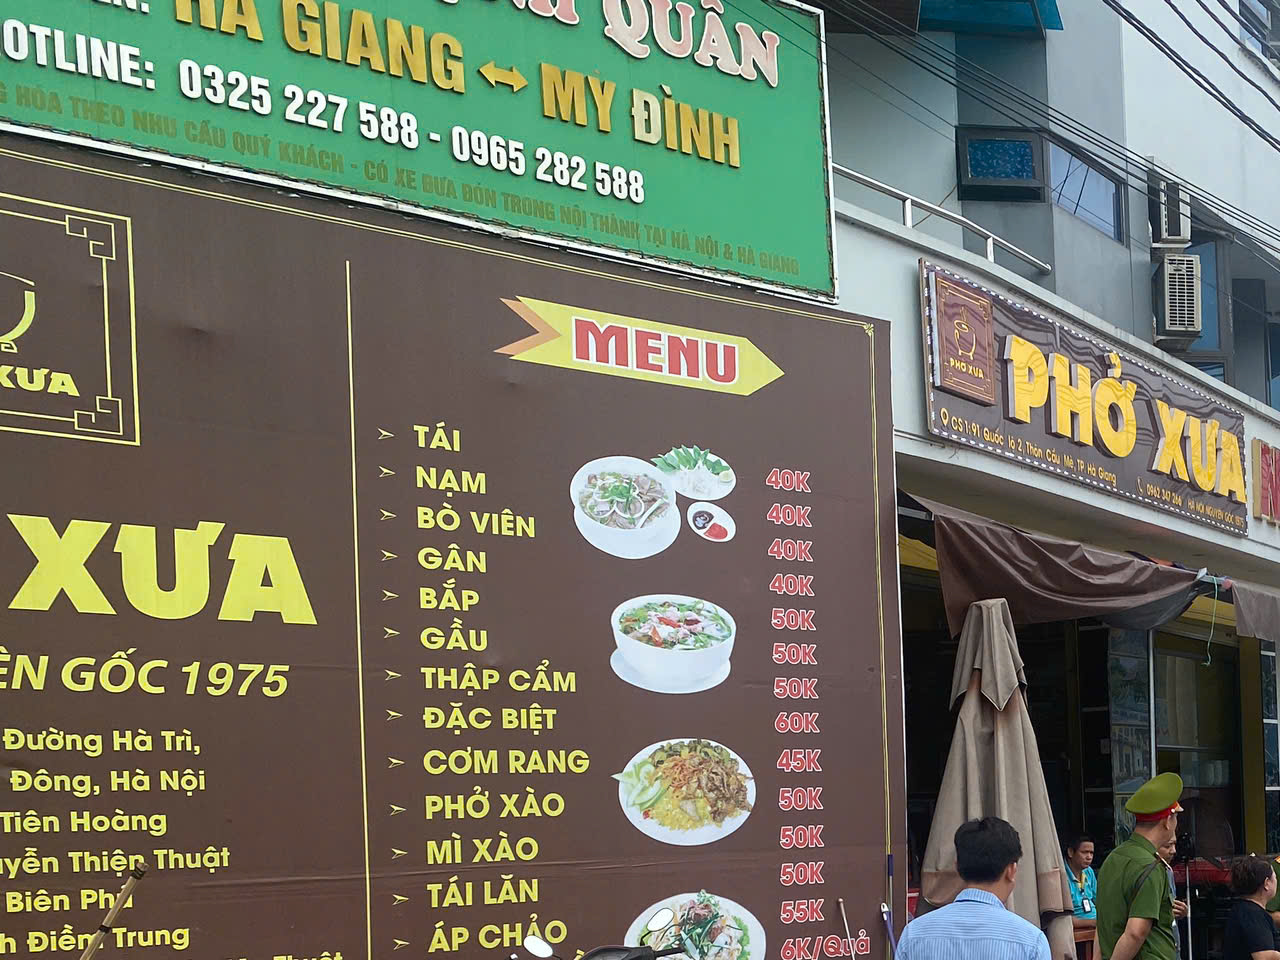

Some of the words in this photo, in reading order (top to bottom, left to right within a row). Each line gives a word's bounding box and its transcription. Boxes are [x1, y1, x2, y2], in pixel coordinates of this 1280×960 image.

[283, 0, 466, 93] GIANG
[631, 84, 741, 168] ĐÌNH
[0, 18, 156, 90] OTLINE:
[179, 58, 272, 115] 0325
[284, 83, 349, 133] 227
[359, 100, 419, 149] 588
[452, 125, 526, 177] 0965
[535, 147, 587, 191] 282
[595, 161, 645, 203] 588
[69, 95, 125, 127] THEO
[132, 109, 177, 137] NHU
[394, 167, 417, 190] XE
[571, 315, 739, 386] MENU
[1003, 335, 1138, 459] PHỞ
[1149, 398, 1247, 504] XƯA
[413, 420, 461, 452] TÁI
[984, 426, 1004, 446] Quốc
[1098, 467, 1117, 486] Giang
[415, 465, 487, 498] NẠM
[765, 469, 811, 494] 40K
[417, 501, 460, 531] BÒ
[470, 508, 536, 538] VIÊN
[767, 503, 812, 528] 40K
[417, 542, 487, 573] GÂN
[768, 538, 814, 563] 40K
[7, 514, 318, 625] XƯA
[419, 578, 480, 612] BẮP
[769, 573, 815, 598] 40K
[420, 617, 488, 652] GẦU
[771, 608, 816, 632] 50K
[772, 642, 817, 666] 50K
[61, 647, 169, 695] GỐC
[181, 661, 290, 698] 1975
[420, 662, 500, 696] THẬP
[508, 659, 577, 693] CẨM
[773, 677, 819, 700] 50K
[422, 702, 492, 735] ĐẶC
[501, 702, 557, 735] BIỆT
[775, 711, 820, 734] 60K
[3, 727, 103, 757] Đường
[112, 729, 153, 752] Hà
[161, 728, 201, 756] Trì,
[423, 746, 498, 776] CƠM
[509, 749, 590, 774] RANG
[777, 749, 822, 773] 45K
[10, 768, 101, 798] Đông,
[110, 768, 150, 792] Hà
[160, 768, 206, 797] Nội
[425, 785, 490, 820] PHỞ
[500, 786, 565, 818] XÀO
[779, 787, 824, 811] 50K
[0, 809, 60, 834] Tiên
[70, 808, 168, 836] Hoàng
[780, 825, 824, 849] 50K
[153, 846, 231, 874] Thuật
[426, 832, 462, 866] MÌ
[472, 831, 539, 864] XÀO
[780, 862, 824, 886] 50K
[6, 888, 70, 913] Biên
[427, 875, 473, 908] TÁI
[484, 873, 539, 905] LĂN
[780, 899, 824, 923] 55K
[112, 926, 190, 951] Trung
[428, 920, 470, 953] ÁP
